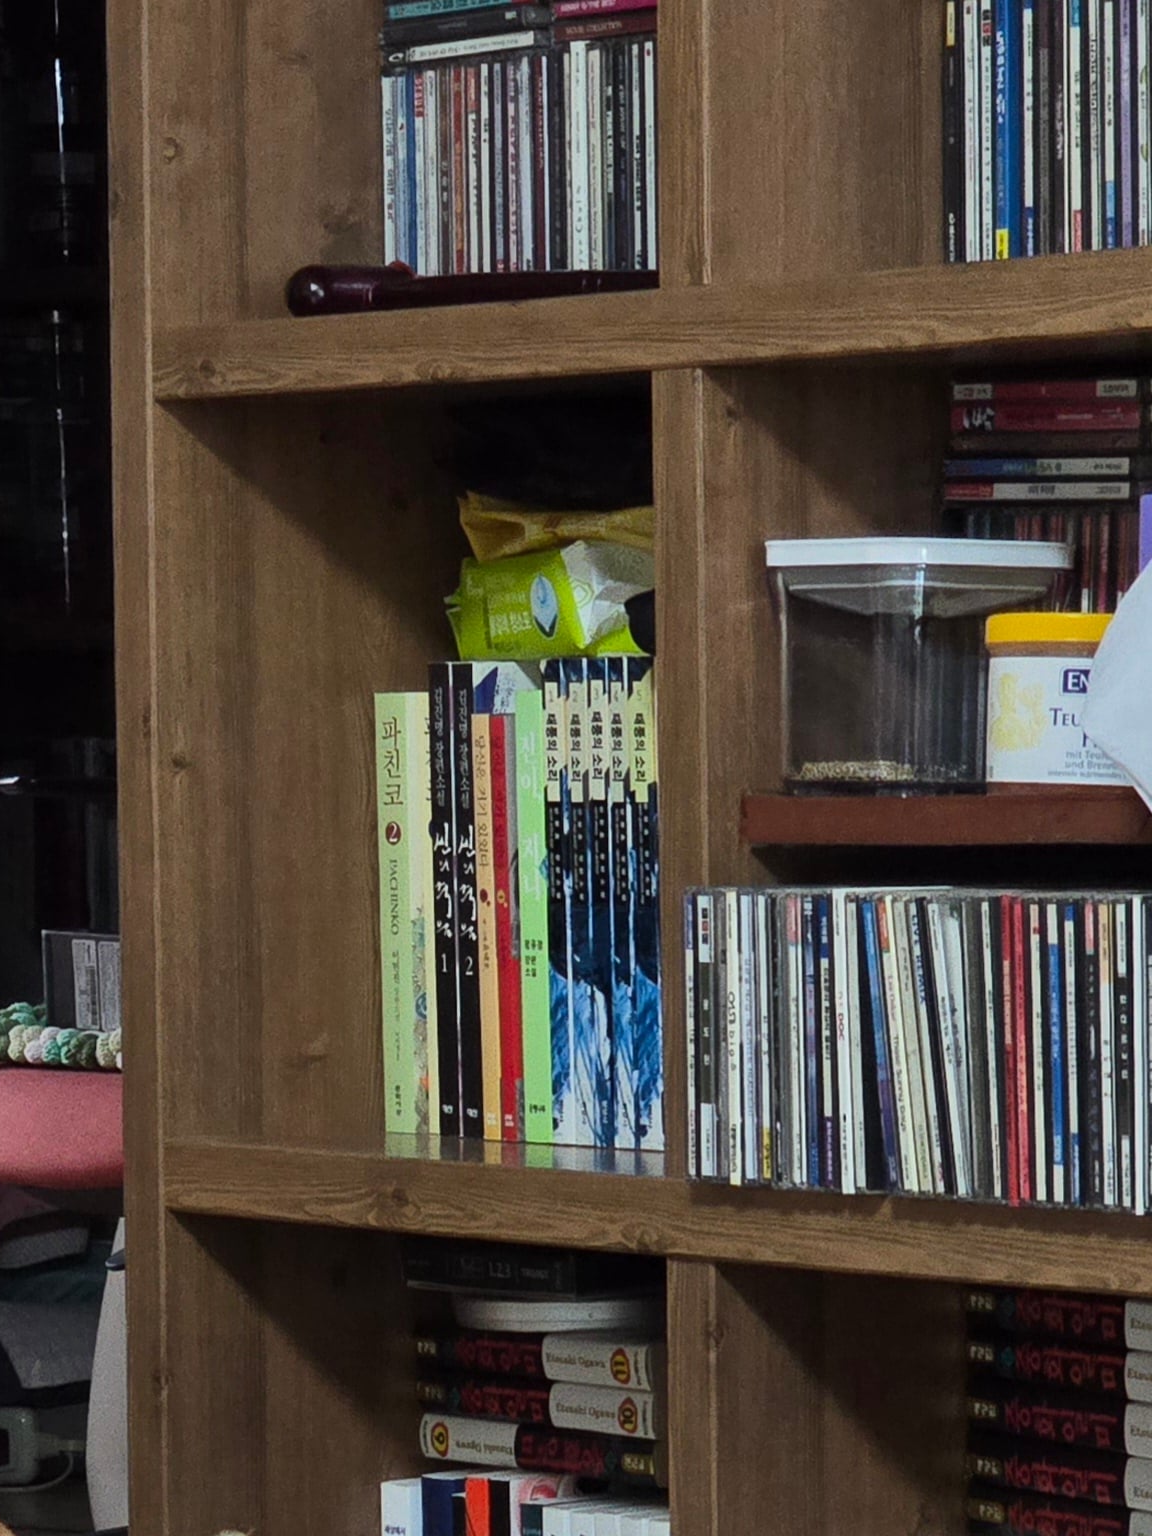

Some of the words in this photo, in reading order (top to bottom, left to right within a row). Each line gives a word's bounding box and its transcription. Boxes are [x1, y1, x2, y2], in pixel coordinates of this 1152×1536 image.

[382, 716, 405, 807] 파친코
[387, 822, 400, 843] 2
[441, 953, 448, 973] 1
[465, 955, 474, 976] 2
[578, 1356, 606, 1370] Ogawa
[588, 1405, 615, 1420] Ogawa
